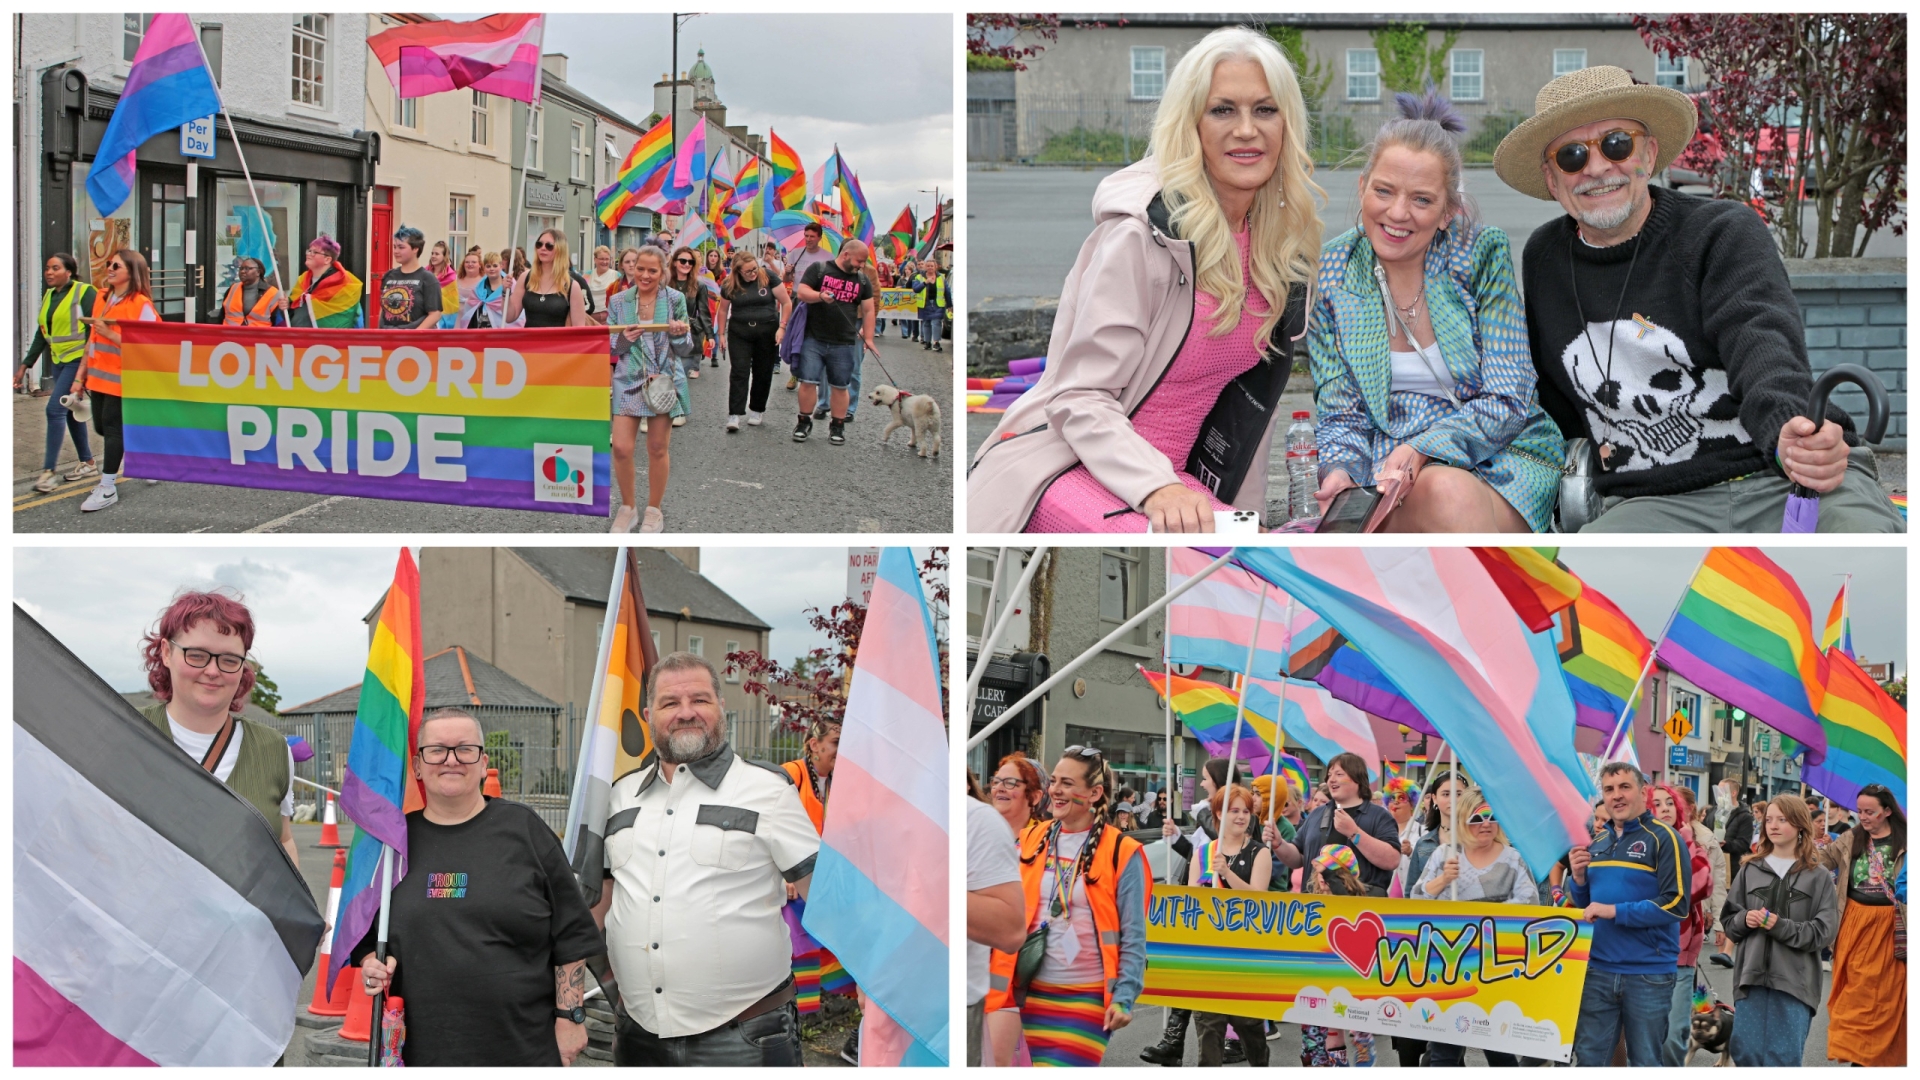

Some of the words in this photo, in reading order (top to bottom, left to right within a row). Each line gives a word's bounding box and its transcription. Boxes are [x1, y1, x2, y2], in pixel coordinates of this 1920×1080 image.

[189, 121, 207, 135] Per
[187, 136, 209, 153] Day
[822, 274, 845, 289] PRIDE
[845, 280, 853, 292] IS
[853, 283, 860, 294] A
[178, 340, 527, 399] LONGFORD
[227, 405, 467, 482] PRIDE
[1293, 441, 1312, 451] ishka
[849, 554, 862, 568] NO
[863, 554, 879, 568] PAR
[860, 572, 877, 585] AFT
[976, 687, 1006, 702] LERY
[427, 872, 468, 888] PROUD
[426, 887, 467, 898] EVERYDAY
[1149, 894, 1205, 931] UTH
[1207, 896, 1326, 937] SERVICE
[1376, 915, 1578, 987] W.Y.L.D.
[1347, 1008, 1370, 1016] National
[1348, 1013, 1369, 1022] Lottery
